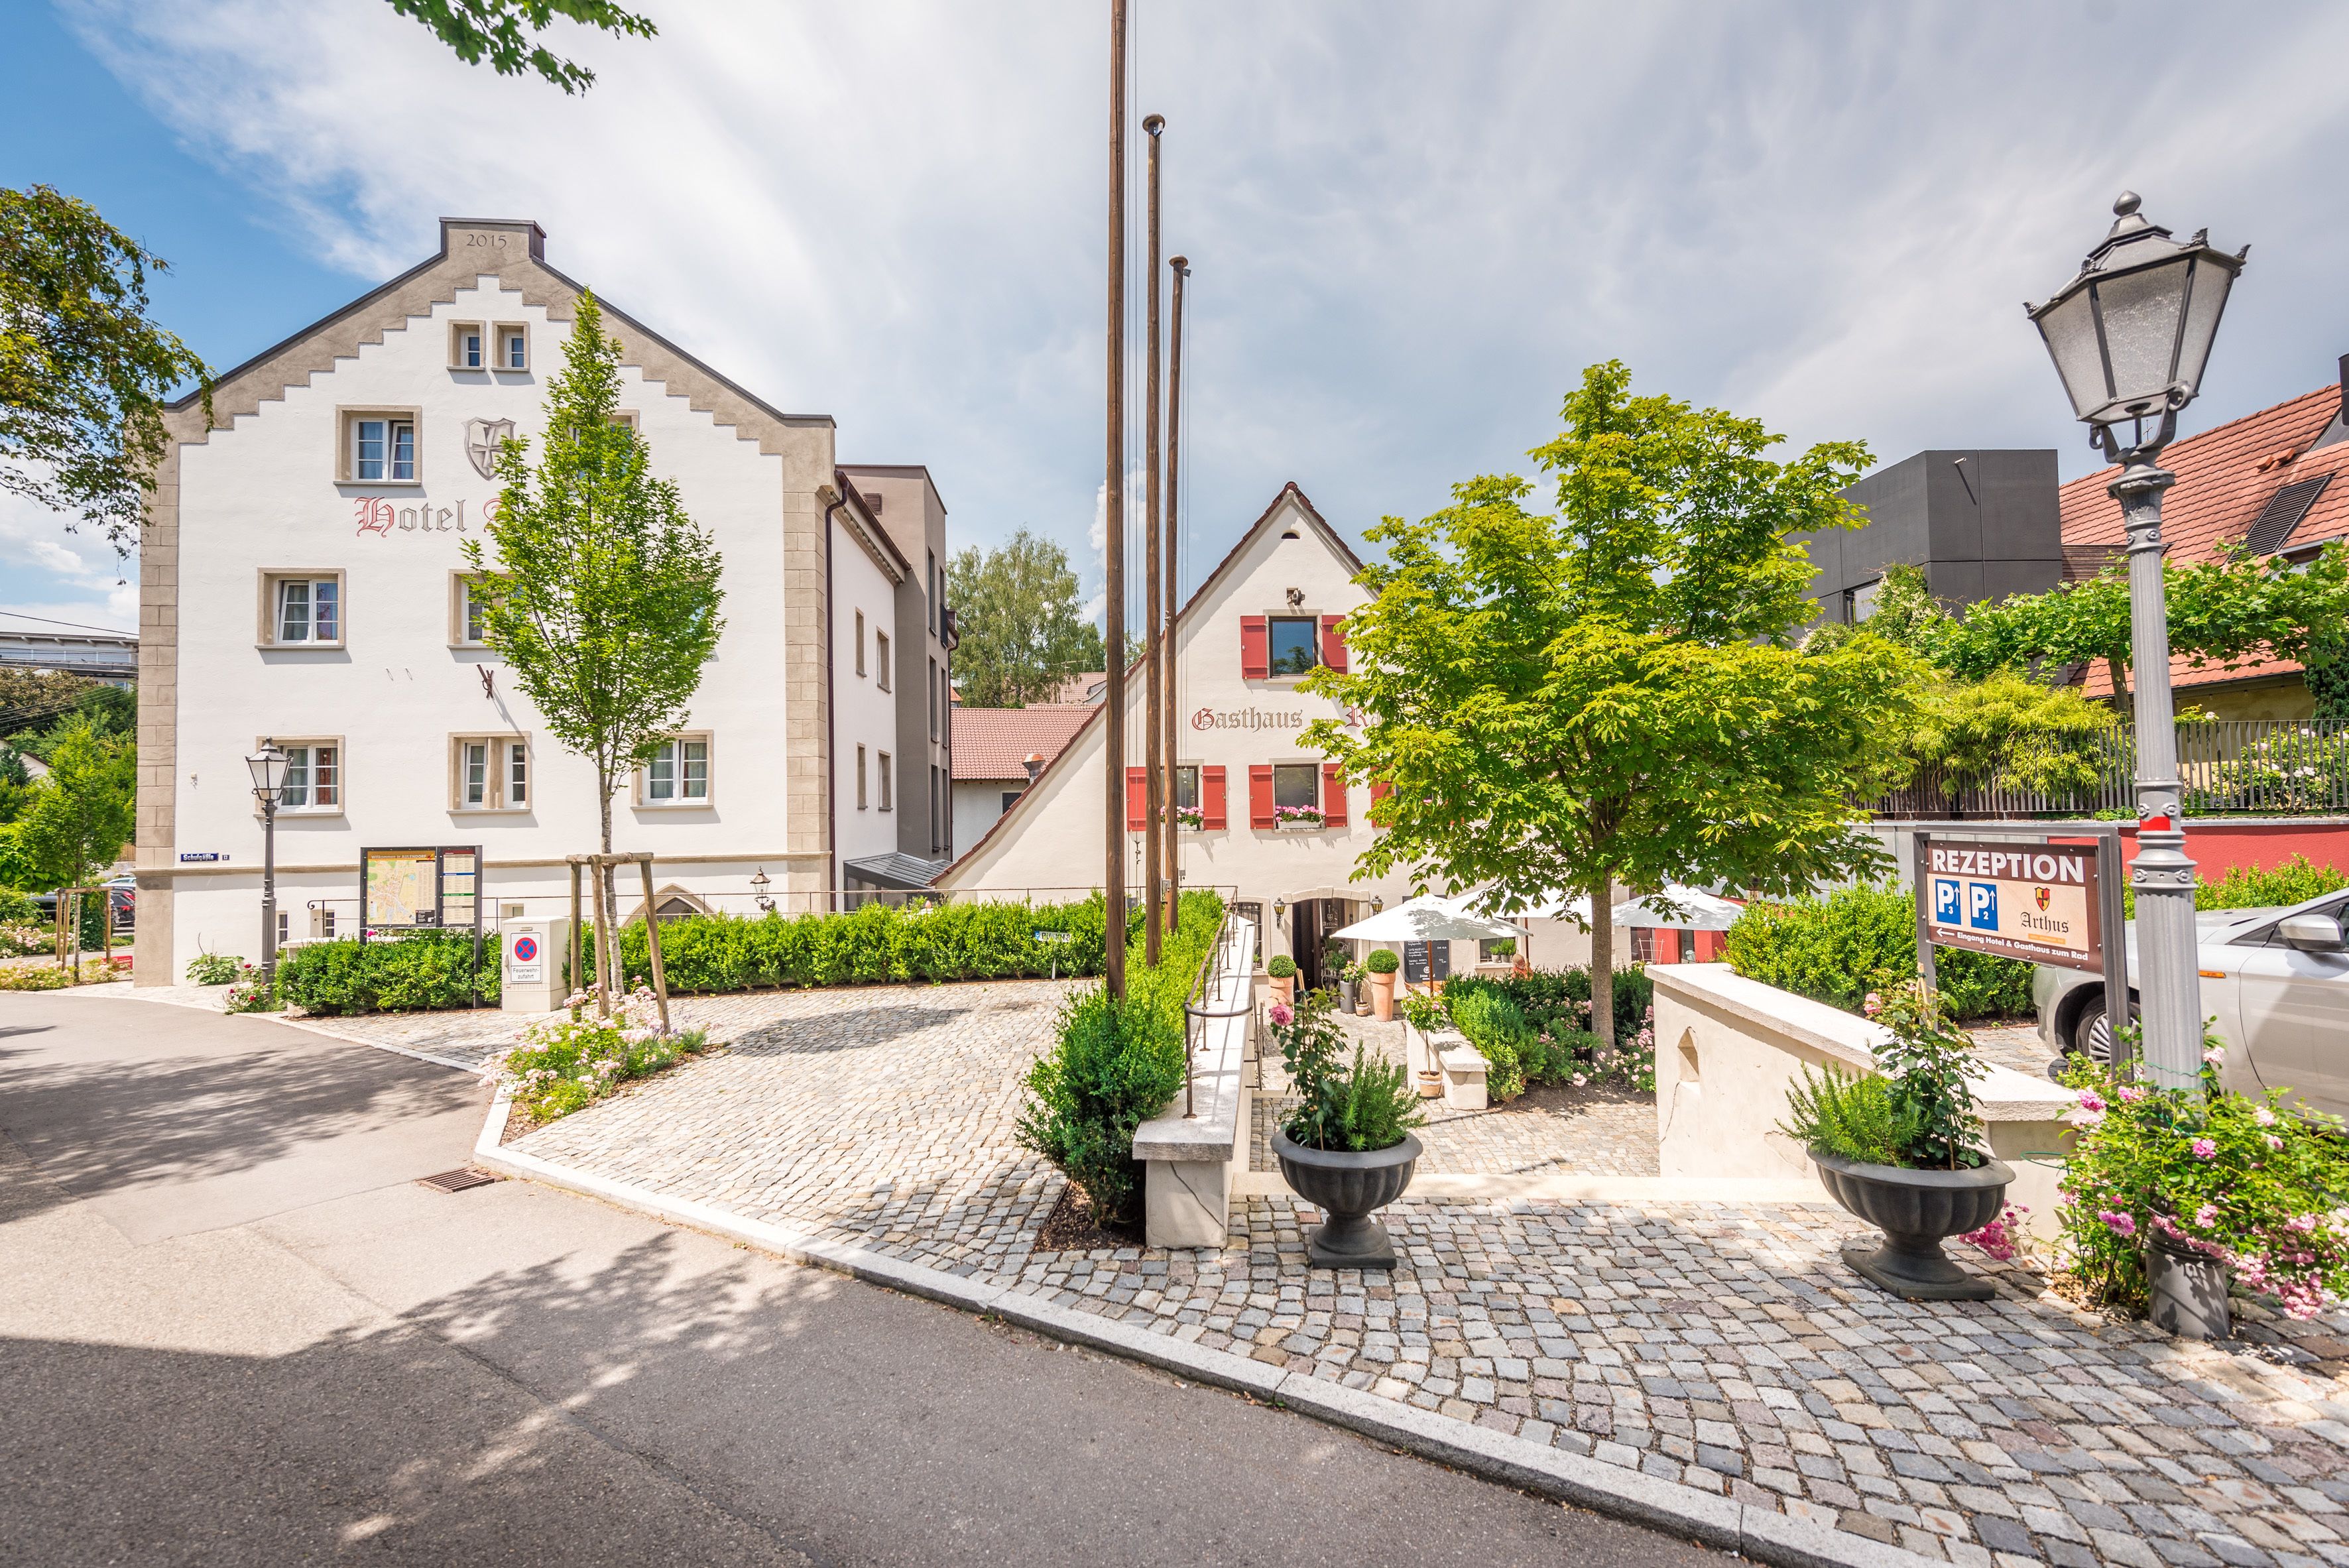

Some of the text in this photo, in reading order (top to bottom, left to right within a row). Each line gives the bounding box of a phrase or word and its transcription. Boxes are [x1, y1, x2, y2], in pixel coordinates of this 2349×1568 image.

[466, 234, 507, 250] 2015
[354, 497, 468, 538] Hotel
[1191, 706, 1303, 733] Gasthaus
[1932, 849, 2084, 882] REZEPTION
[2020, 912, 2069, 934] Arthus
[1957, 932, 1984, 943] Eingang
[1986, 936, 2004, 946] Hotel
[2014, 941, 2050, 954] Gasthaus
[2051, 949, 2069, 957] zum
[2071, 951, 2088, 961] Rad
